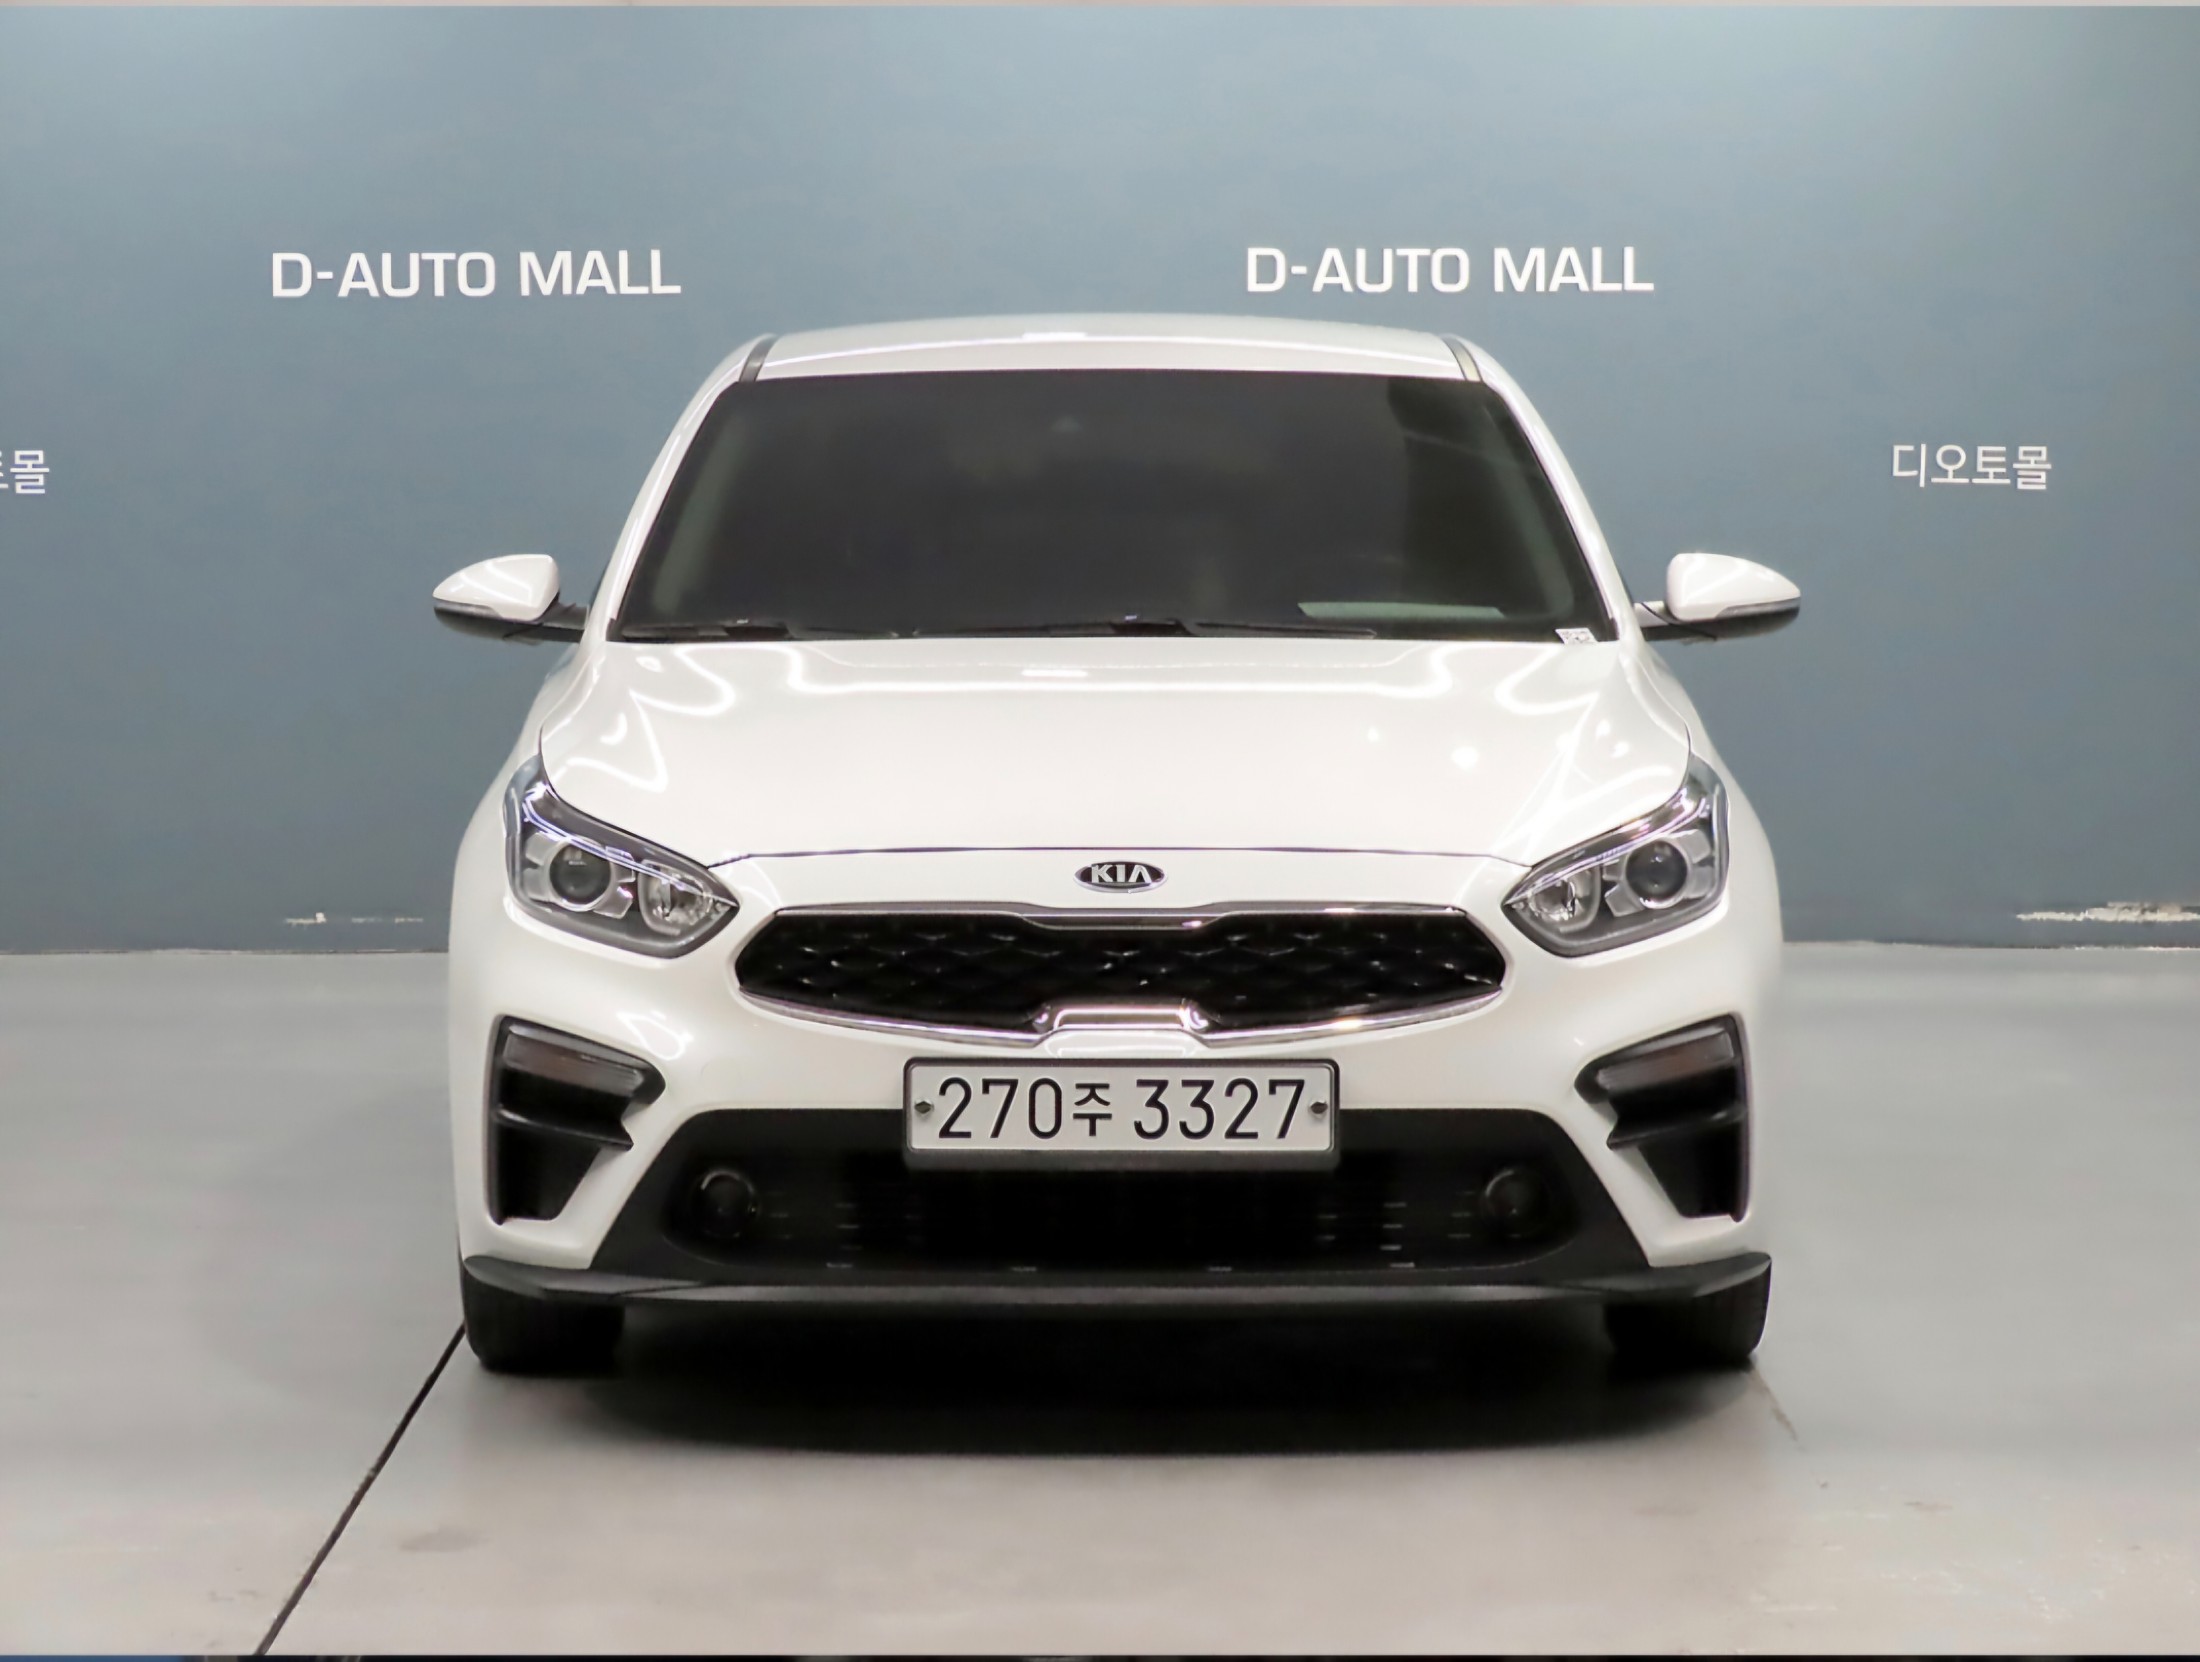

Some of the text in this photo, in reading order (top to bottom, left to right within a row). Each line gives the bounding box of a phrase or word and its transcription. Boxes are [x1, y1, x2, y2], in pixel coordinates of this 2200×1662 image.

[271, 248, 682, 298] D-AUTO MALL
[1246, 246, 1655, 293] D-AUTO MALL
[0, 449, 50, 494] 몰
[1892, 443, 2052, 490] 디오토몰
[1091, 864, 1152, 884] KIA
[938, 1076, 1306, 1140] 270주 3327
